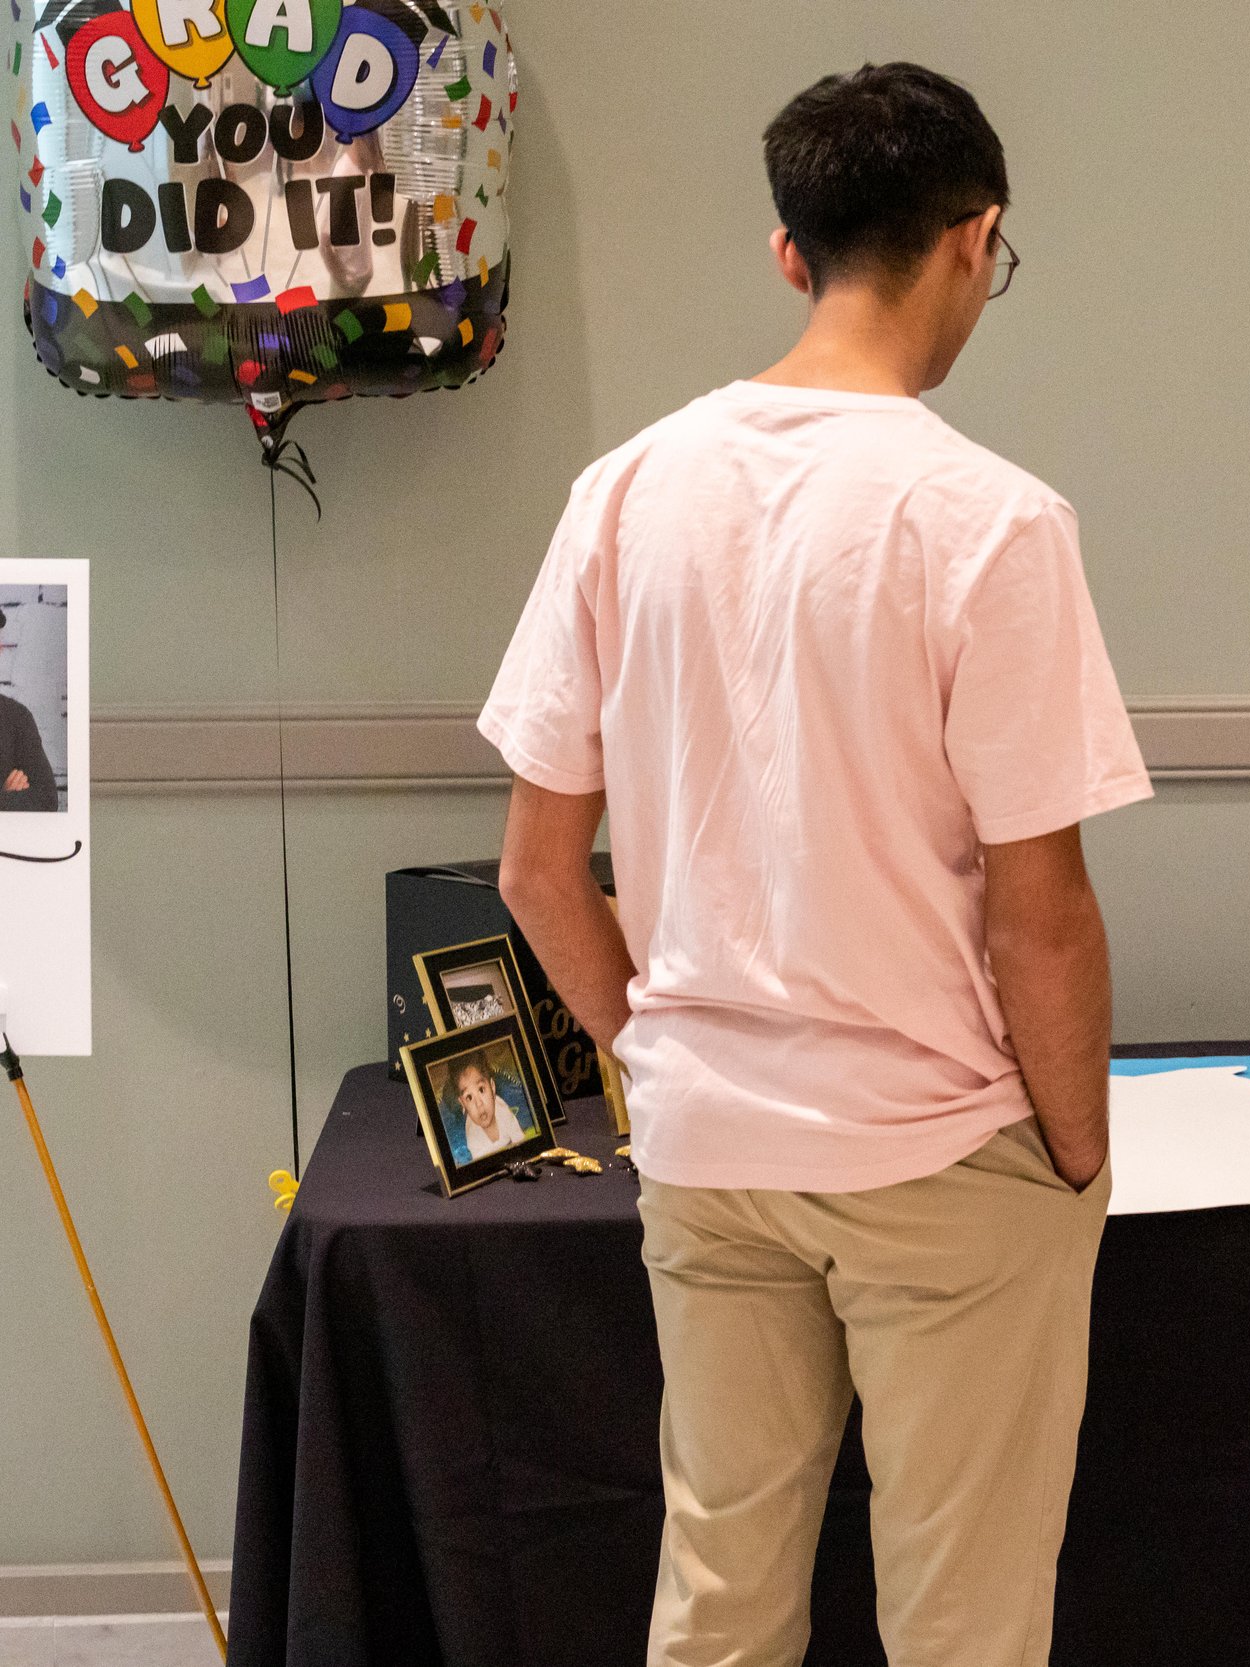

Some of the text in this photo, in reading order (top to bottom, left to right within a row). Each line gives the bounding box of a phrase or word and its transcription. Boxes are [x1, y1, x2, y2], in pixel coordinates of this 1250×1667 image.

[84, 0, 397, 113] GRAD
[158, 102, 325, 165] YOU
[101, 173, 397, 255] DID IT!
